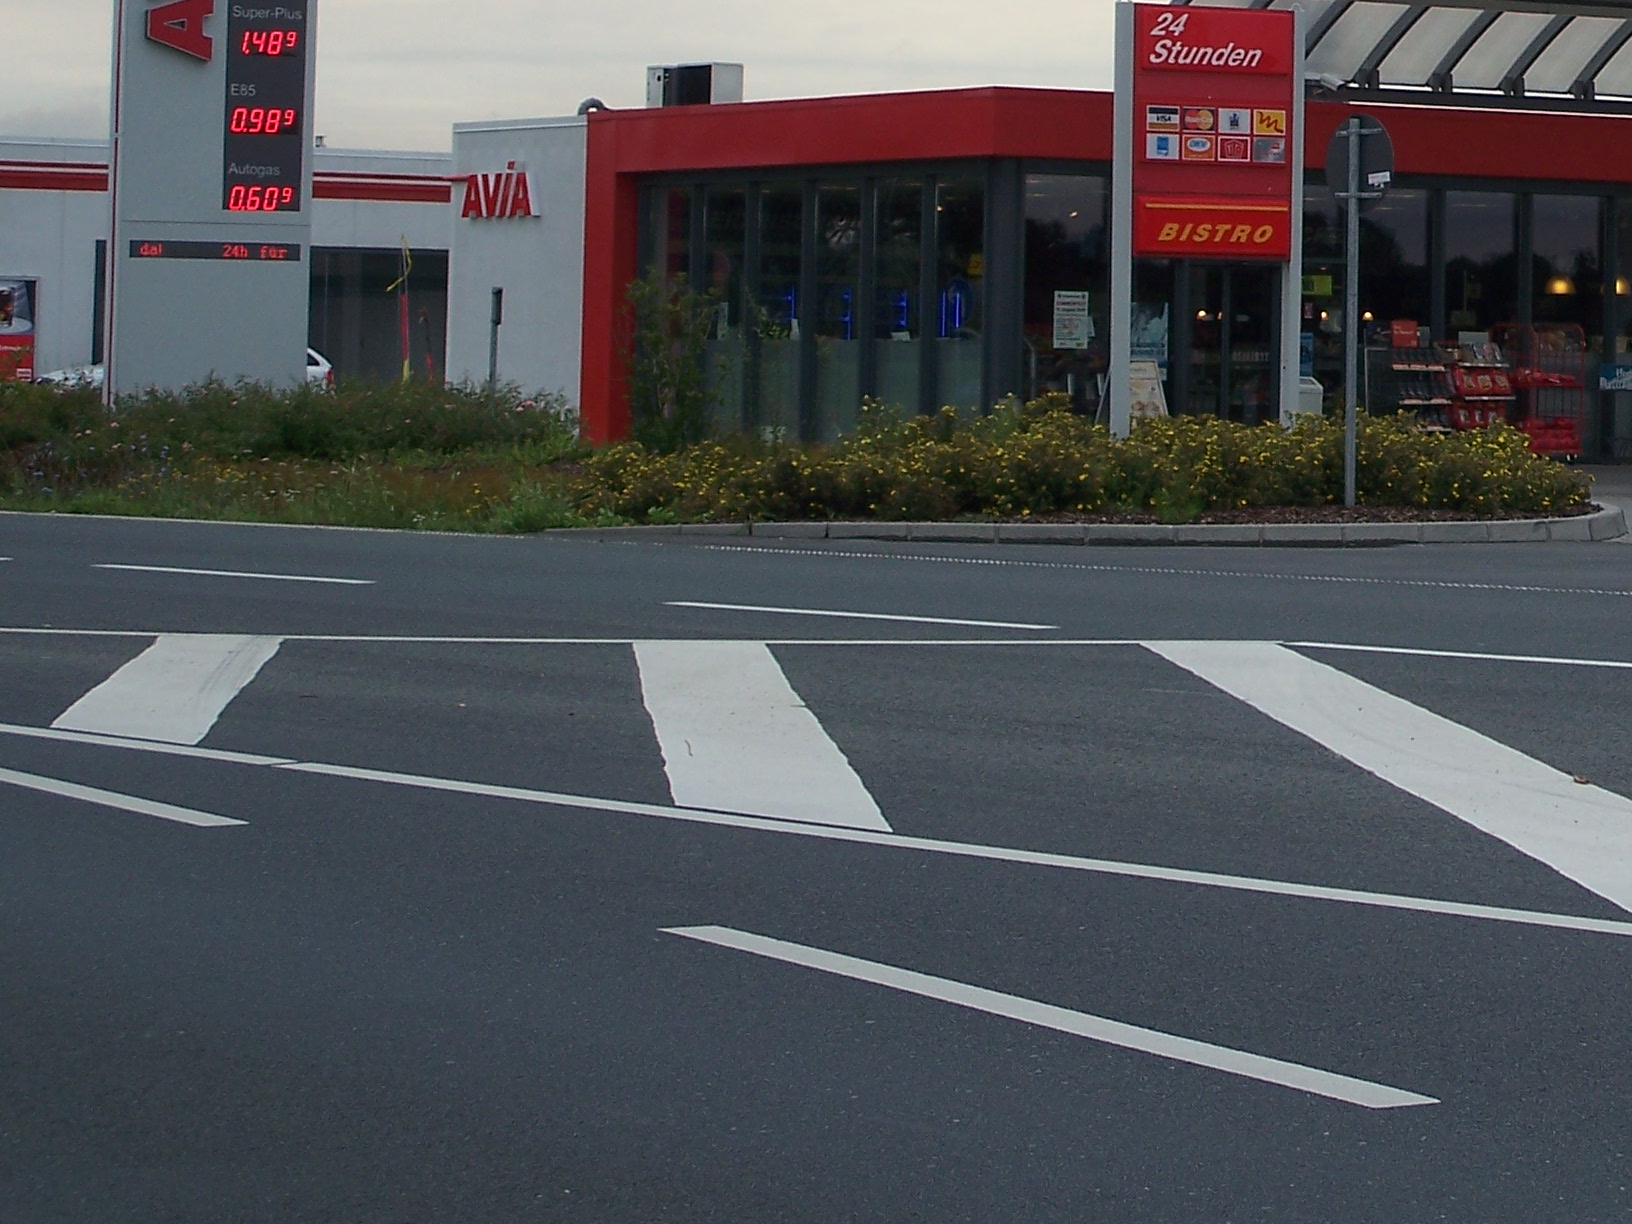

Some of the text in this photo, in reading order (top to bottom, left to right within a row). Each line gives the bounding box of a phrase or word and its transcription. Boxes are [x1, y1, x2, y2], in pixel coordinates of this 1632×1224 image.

[232, 5, 302, 20] Super-Plus
[1150, 12, 1189, 37] 24
[1150, 39, 1263, 68] Stunden
[230, 83, 256, 97] E85
[228, 162, 281, 178] Autogas
[1158, 222, 1274, 244] BISTRO
